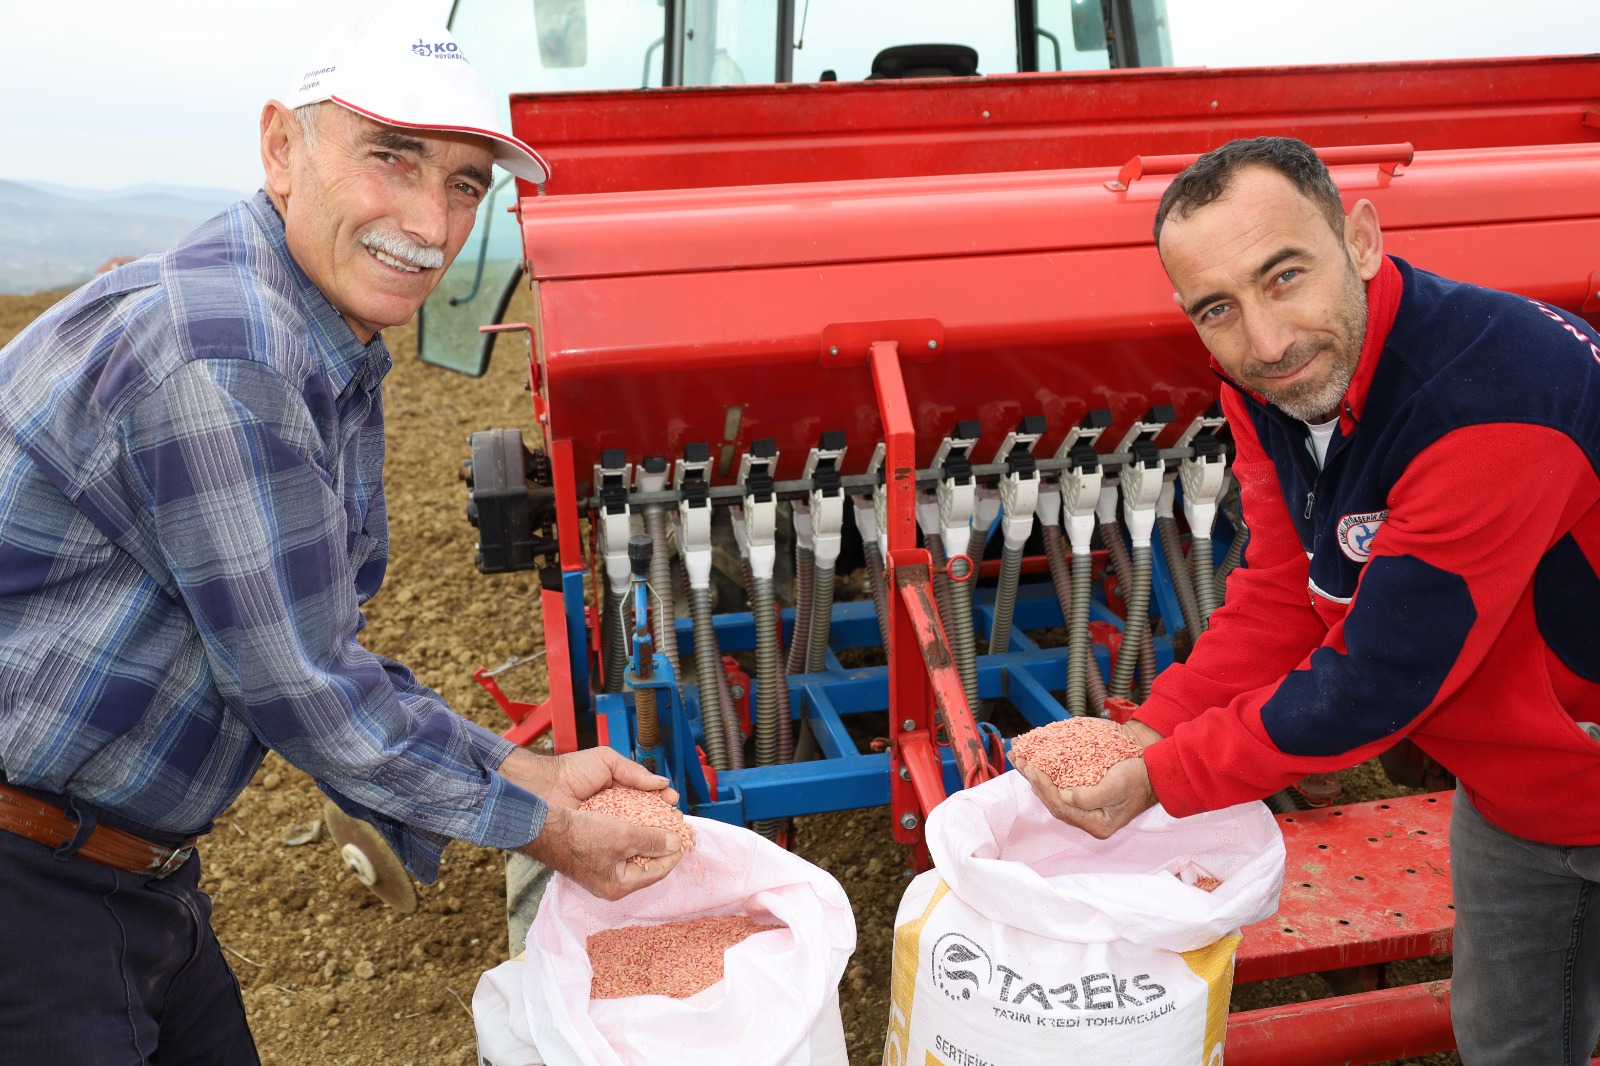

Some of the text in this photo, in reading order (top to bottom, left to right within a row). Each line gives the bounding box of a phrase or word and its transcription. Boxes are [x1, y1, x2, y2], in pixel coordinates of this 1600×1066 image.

[996, 963, 1167, 1010] TAREKS
[992, 1000, 1177, 1028] TARIM KREDİ TOHUMCULUK
[935, 1034, 995, 1066] SERTİFİK
